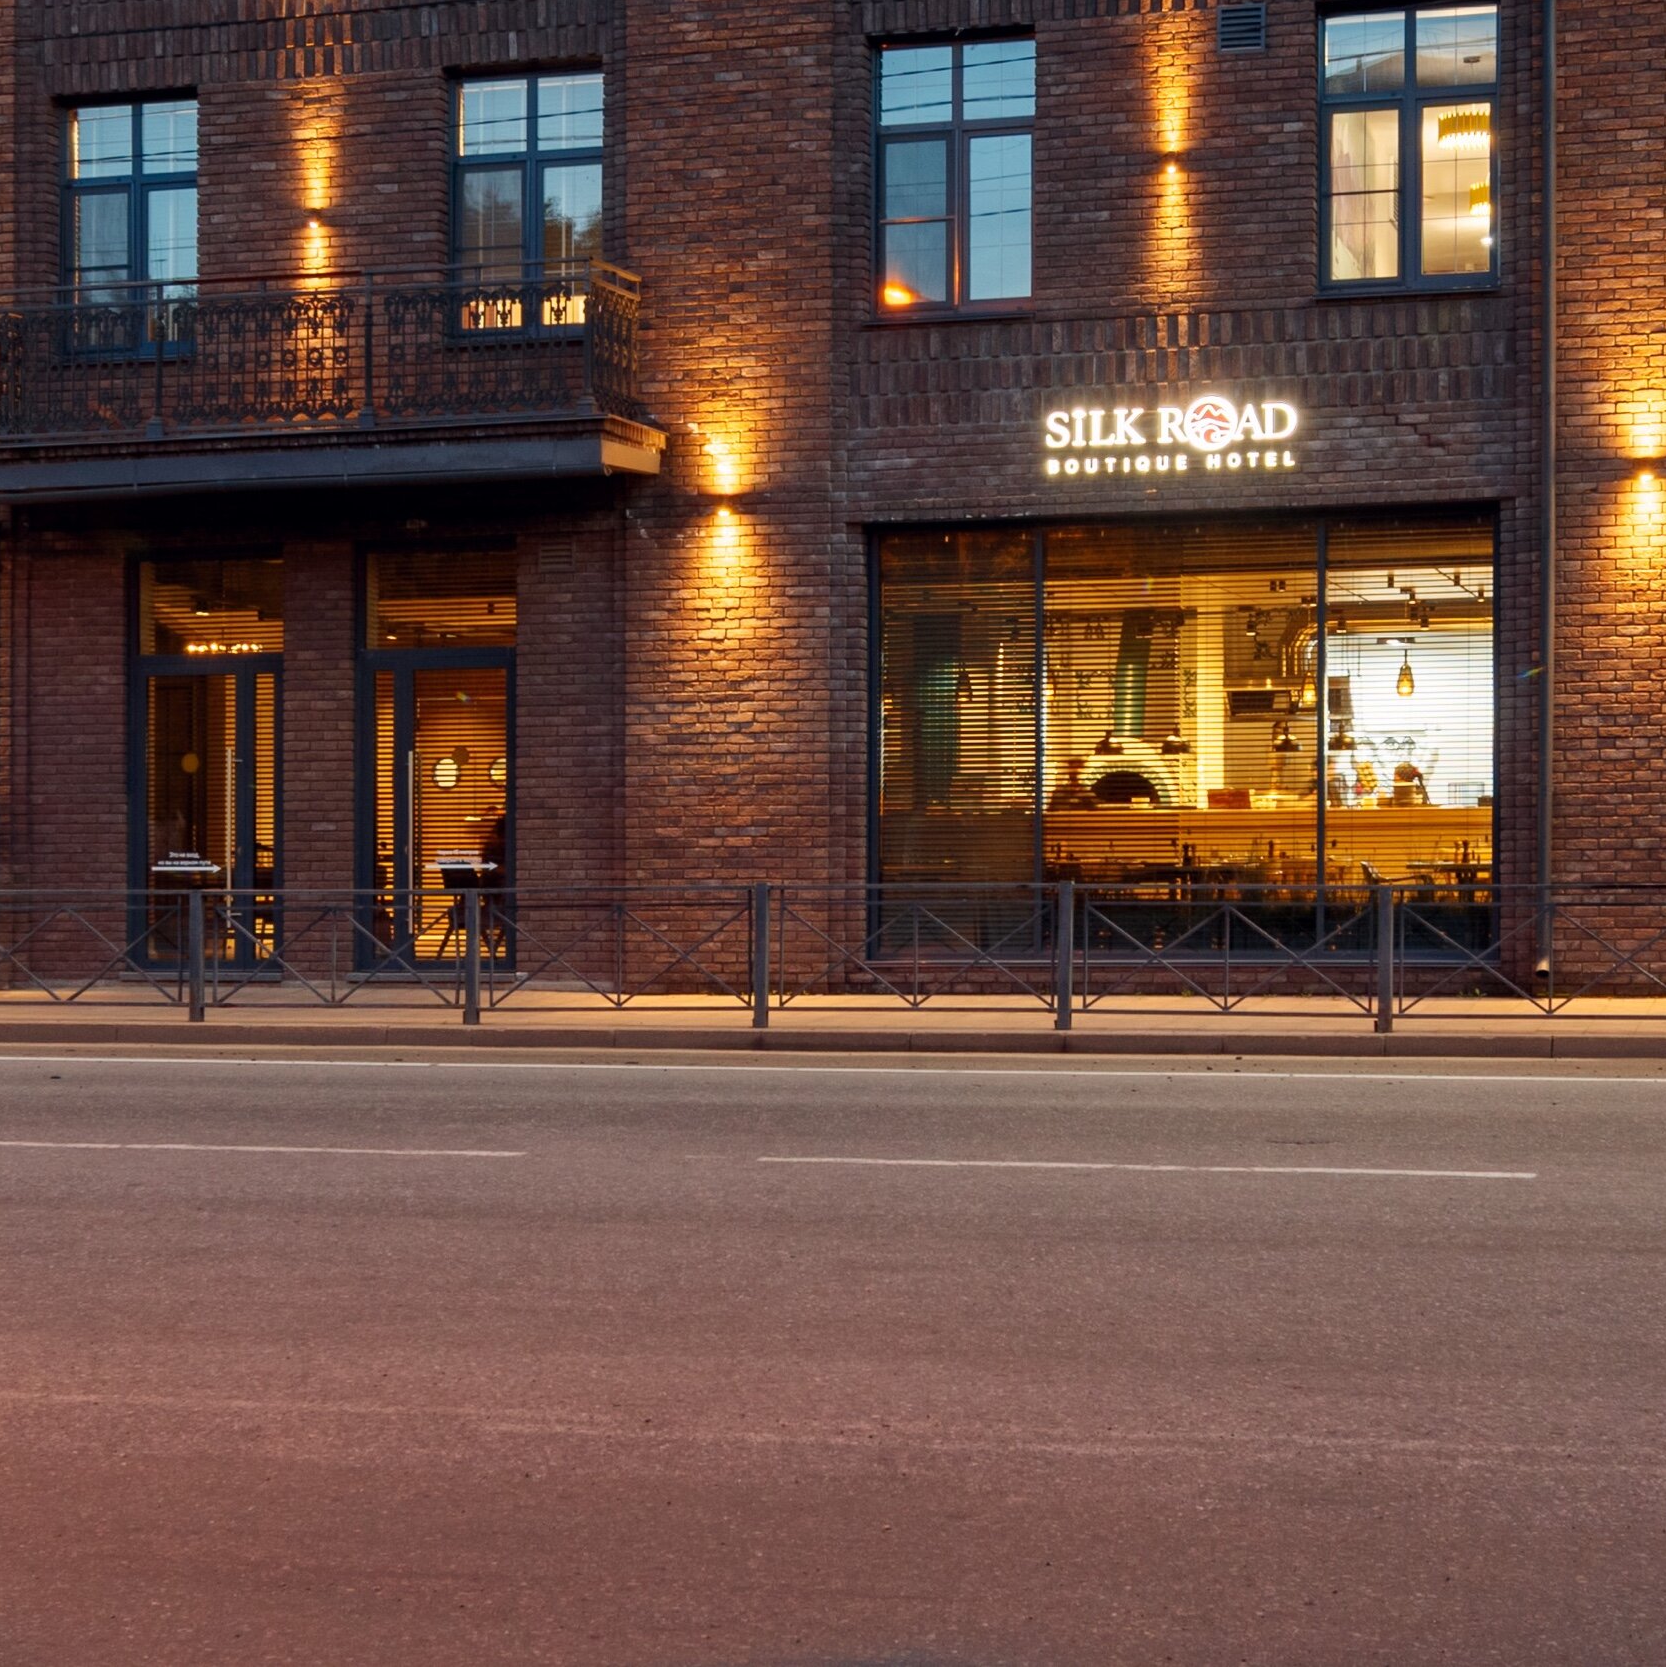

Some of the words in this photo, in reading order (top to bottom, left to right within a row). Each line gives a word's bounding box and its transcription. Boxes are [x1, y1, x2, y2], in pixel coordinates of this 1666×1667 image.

[1156, 395, 1298, 451] ROAD
[1047, 454, 1188, 475] BOUTIQUE
[1207, 450, 1297, 469] HOTEL
